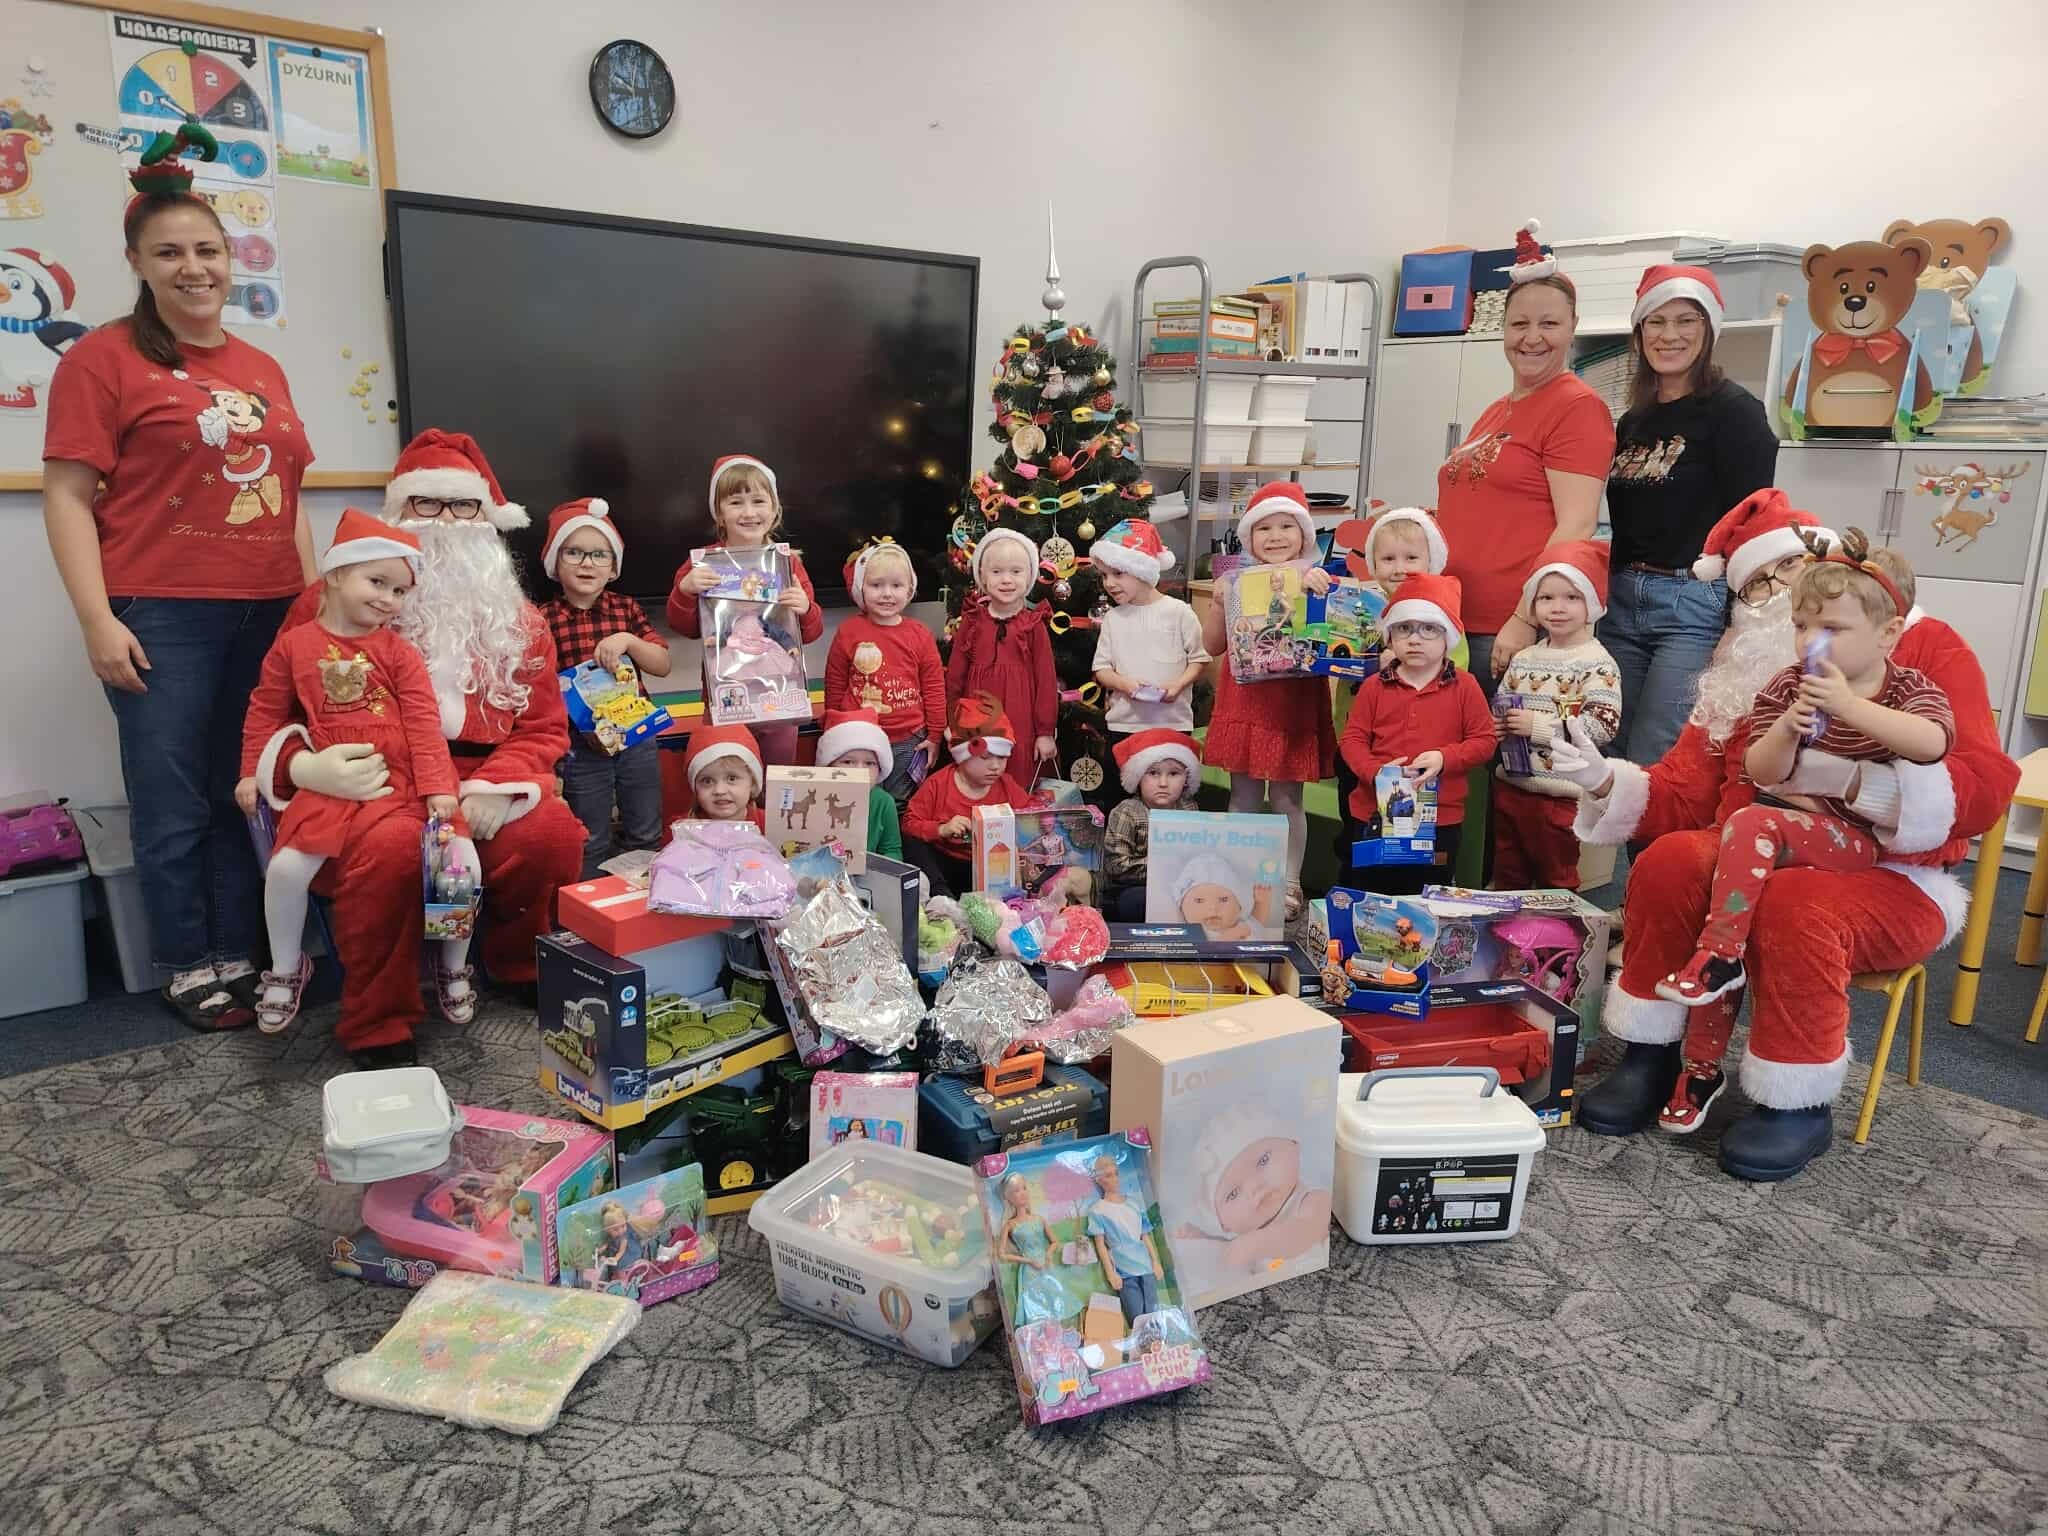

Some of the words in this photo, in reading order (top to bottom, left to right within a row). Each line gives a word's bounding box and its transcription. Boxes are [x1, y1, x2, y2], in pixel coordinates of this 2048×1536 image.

[166, 65, 177, 82] 1
[204, 71, 219, 88] 2
[282, 61, 353, 86] DYŻURNI
[232, 102, 246, 118] 3
[1151, 827, 1221, 849] Lovely
[1143, 998, 1187, 1010] JUMBO
[557, 1073, 603, 1116] bruder
[777, 1251, 800, 1271] TUBE
[800, 1262, 831, 1284] BLOCK
